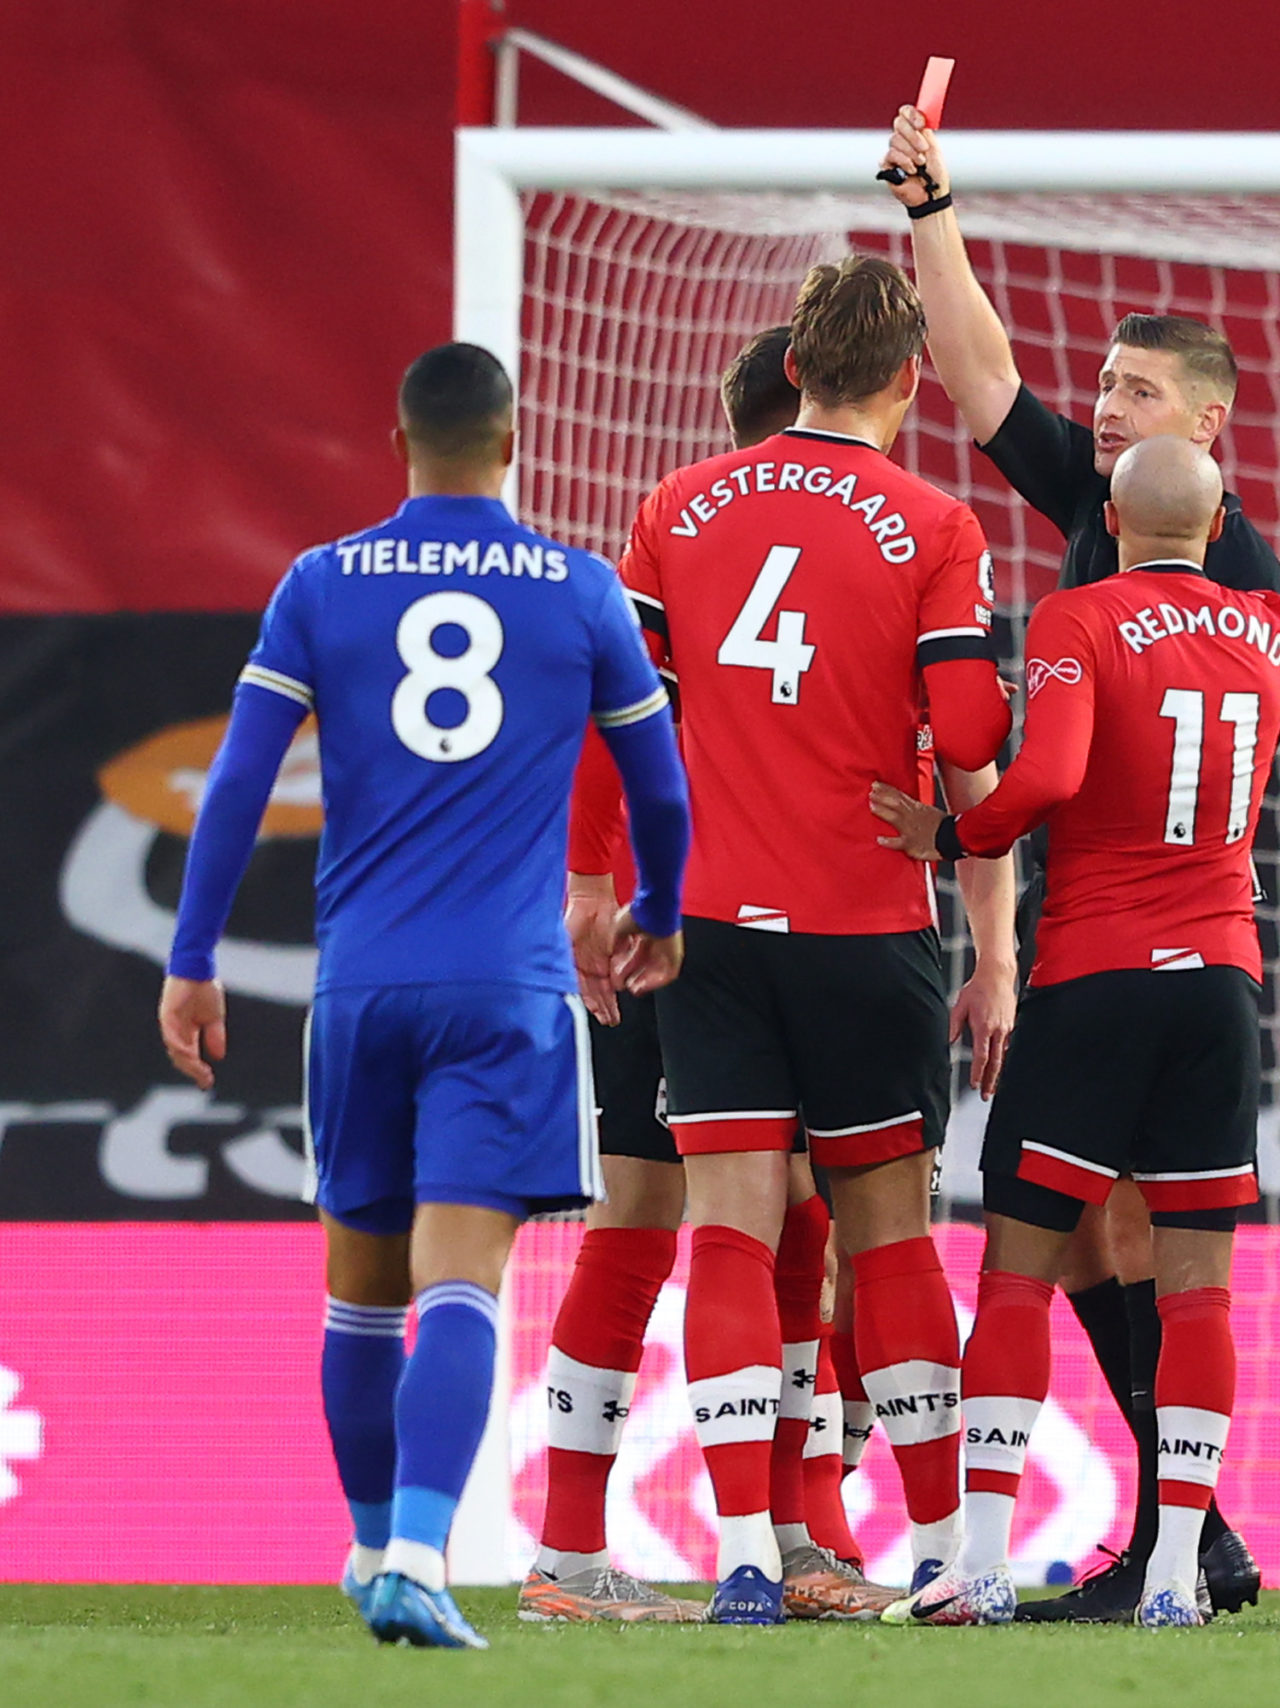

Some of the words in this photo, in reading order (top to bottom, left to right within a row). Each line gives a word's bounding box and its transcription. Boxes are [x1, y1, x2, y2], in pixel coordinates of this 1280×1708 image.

[336, 539, 569, 582] TIELEMANS
[669, 462, 917, 564] VESTERGAARD
[717, 545, 817, 705] 4
[390, 590, 504, 763] 8
[1159, 688, 1260, 846] 11
[695, 1398, 780, 1423] SAINT
[729, 1601, 764, 1612] COPA
